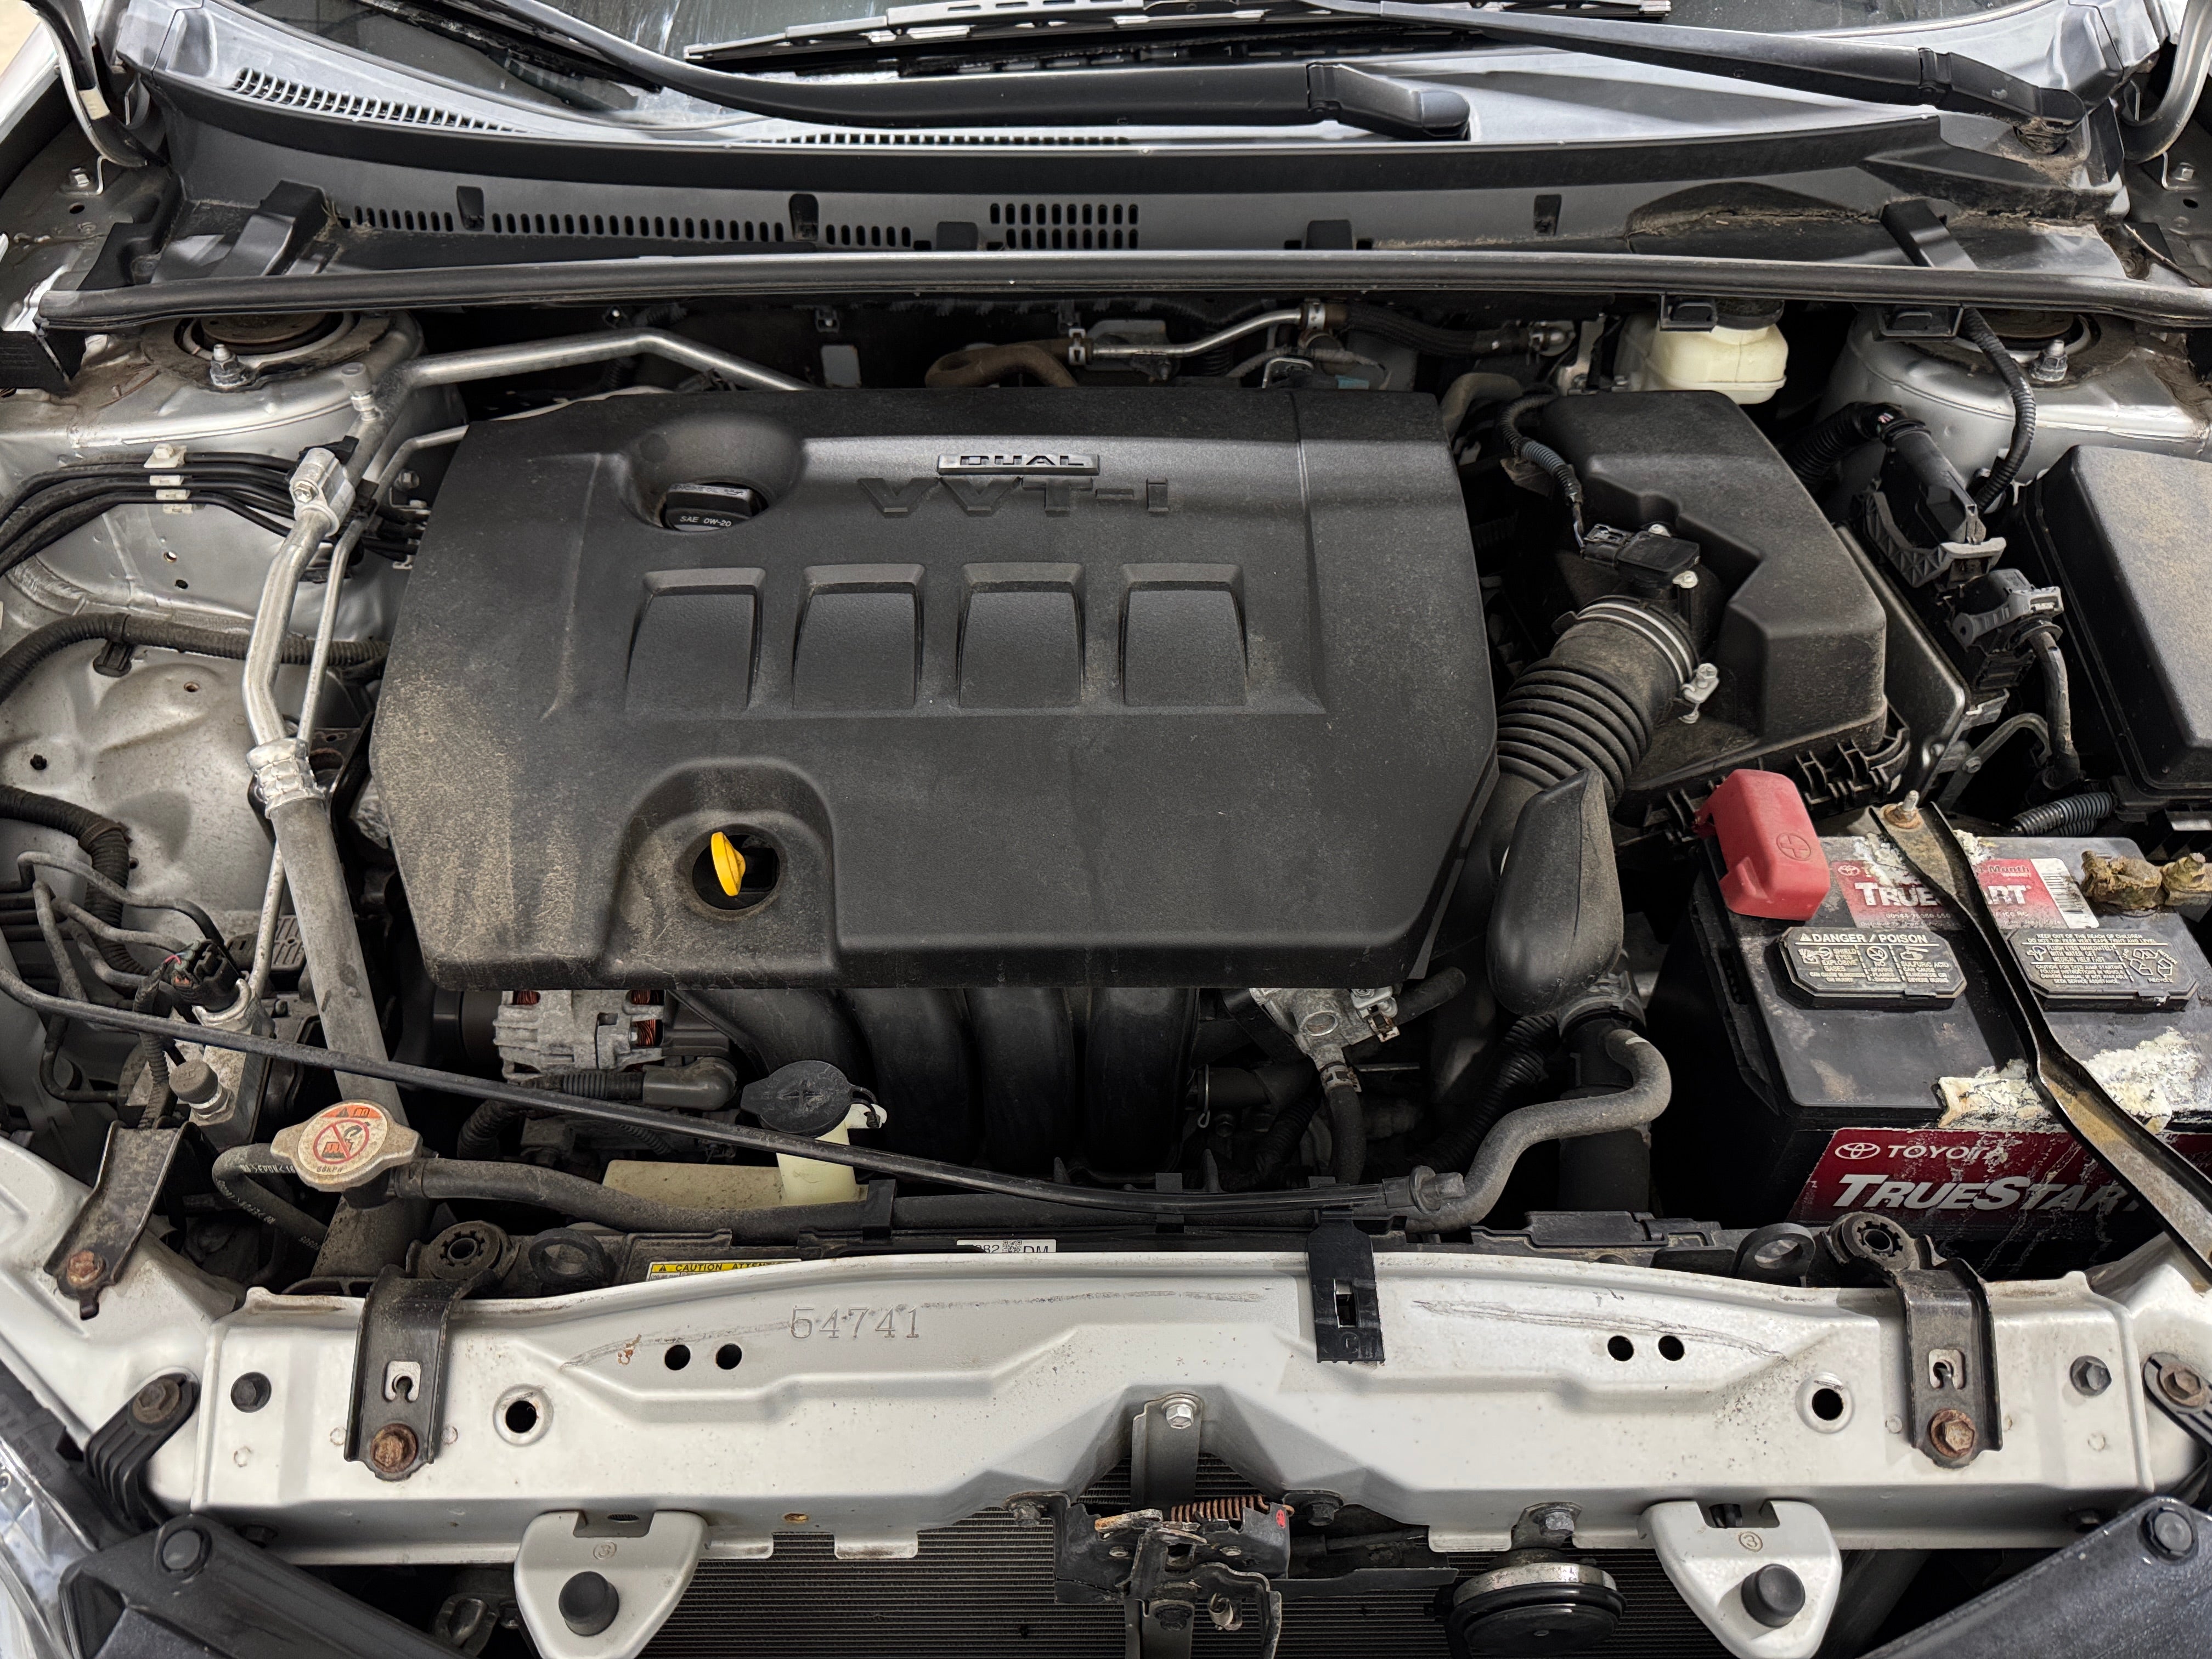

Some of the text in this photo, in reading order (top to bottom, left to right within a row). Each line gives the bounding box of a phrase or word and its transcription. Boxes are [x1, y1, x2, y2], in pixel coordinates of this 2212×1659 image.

[960, 455, 1085, 466] DUAL
[703, 518, 732, 527] 0W-20
[1812, 933, 1867, 943] DANGER
[1878, 934, 1928, 943] POISON
[675, 1263, 723, 1272] CAUTION
